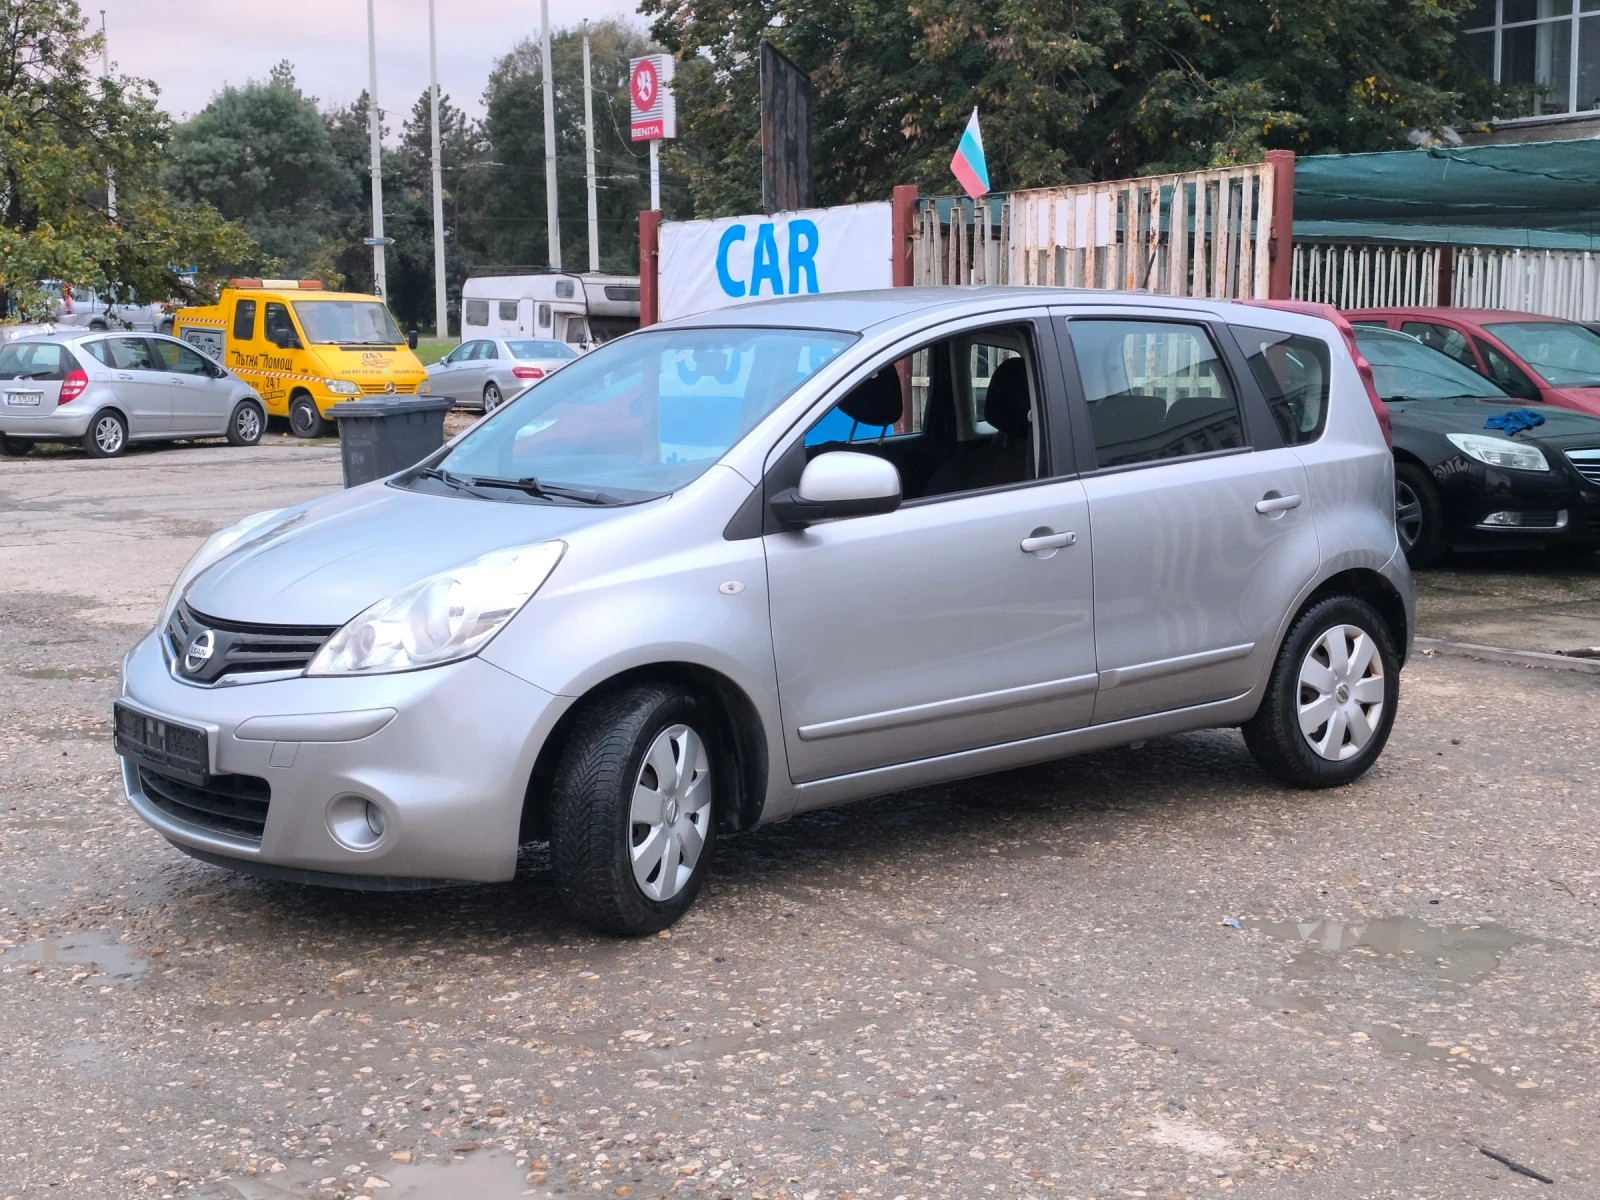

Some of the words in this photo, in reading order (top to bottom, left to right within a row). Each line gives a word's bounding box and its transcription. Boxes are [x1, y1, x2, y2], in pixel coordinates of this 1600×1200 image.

[631, 126, 660, 137] BENITA
[716, 219, 820, 298] CAR
[263, 357, 293, 373] ПОМОЩ
